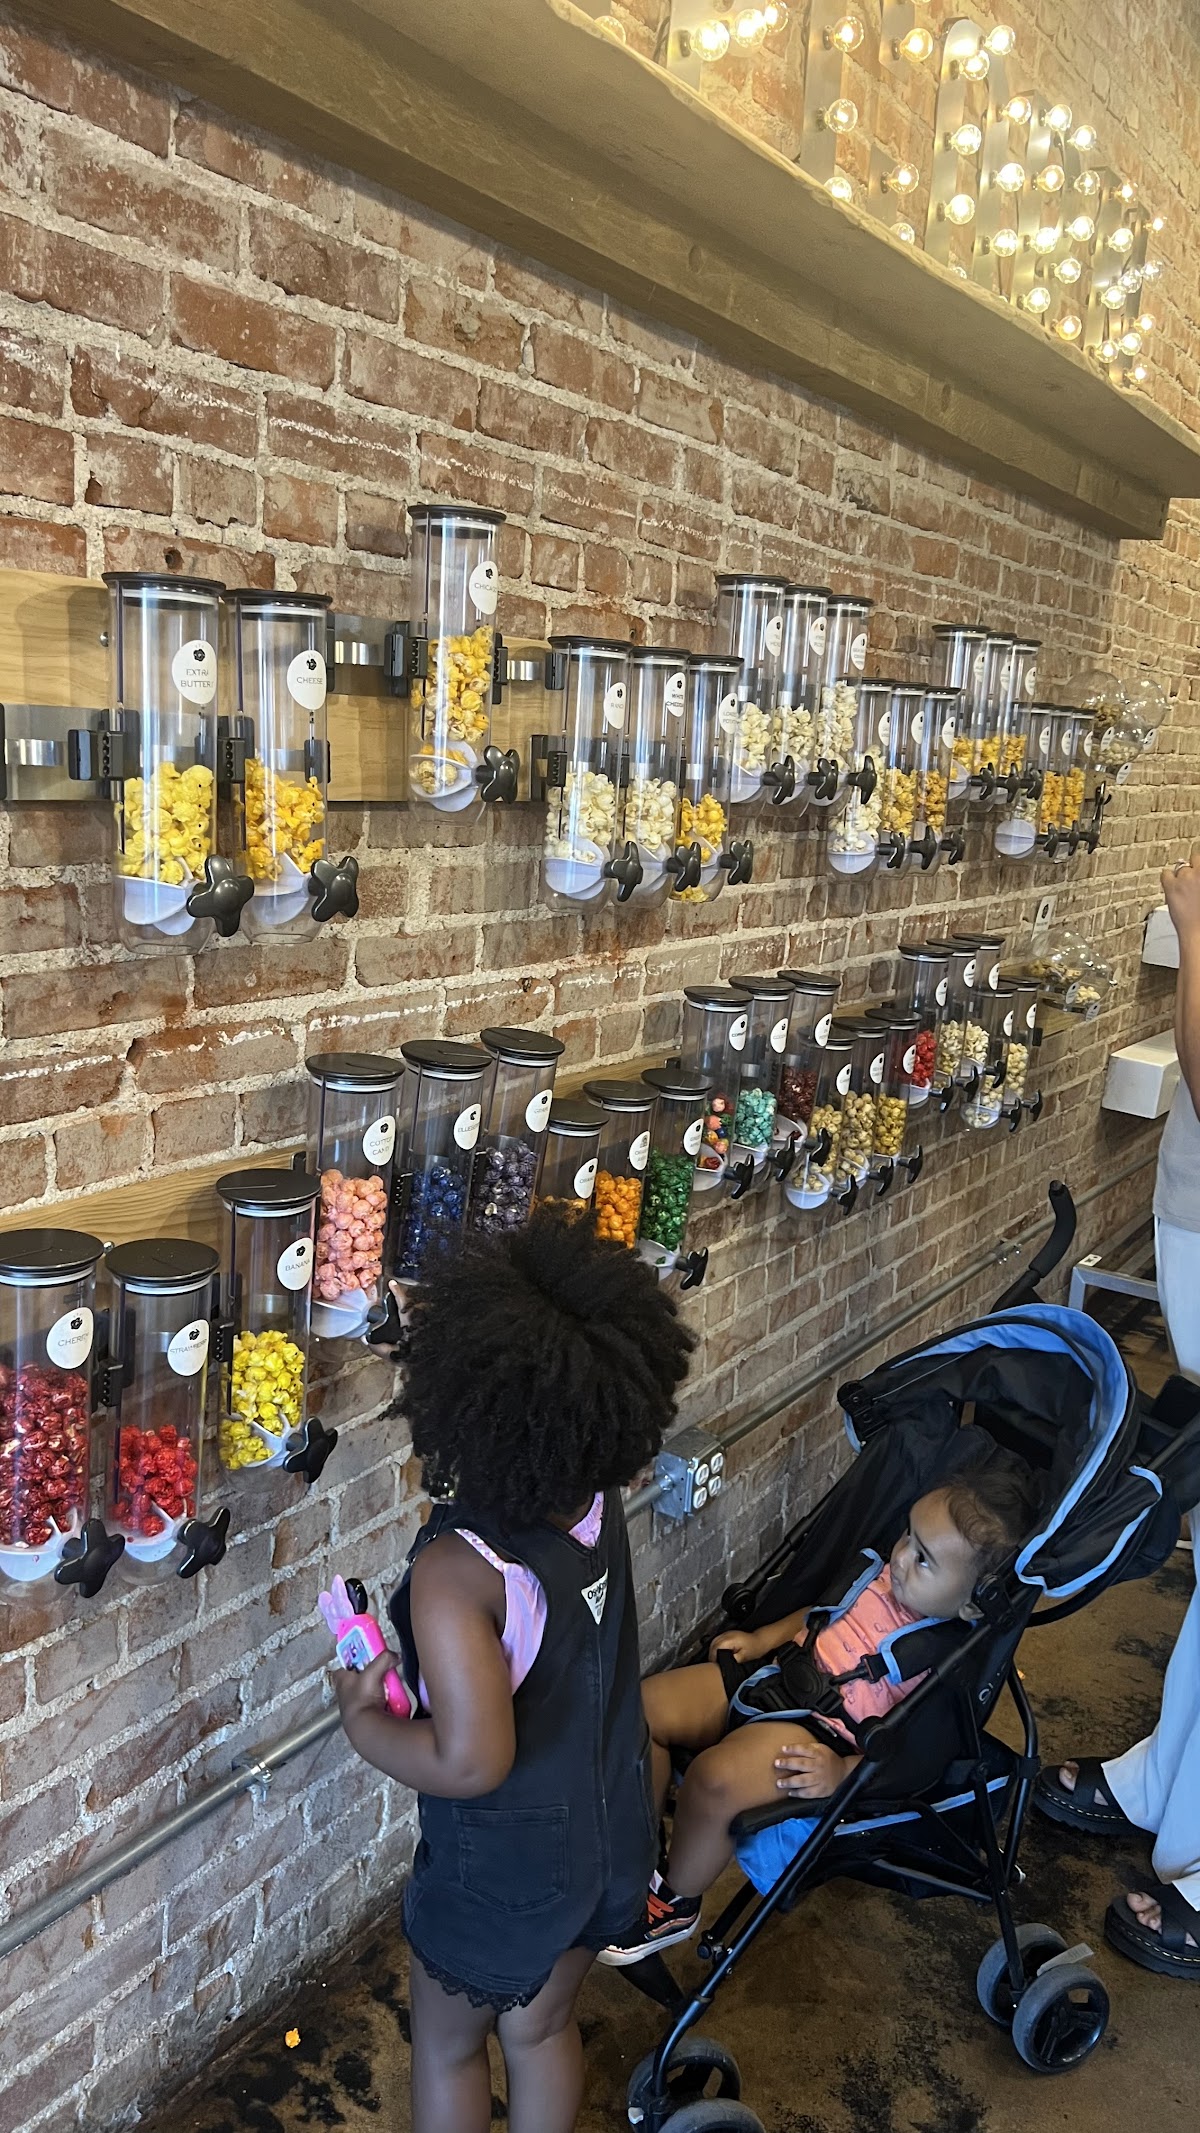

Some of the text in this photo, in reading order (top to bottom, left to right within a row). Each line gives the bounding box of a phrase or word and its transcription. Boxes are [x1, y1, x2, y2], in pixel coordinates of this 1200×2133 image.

[296, 676, 323, 685] CHEESE
[372, 1146, 390, 1156] CAND
[285, 1258, 311, 1271] BANANA
[57, 1332, 90, 1347] CHERRY
